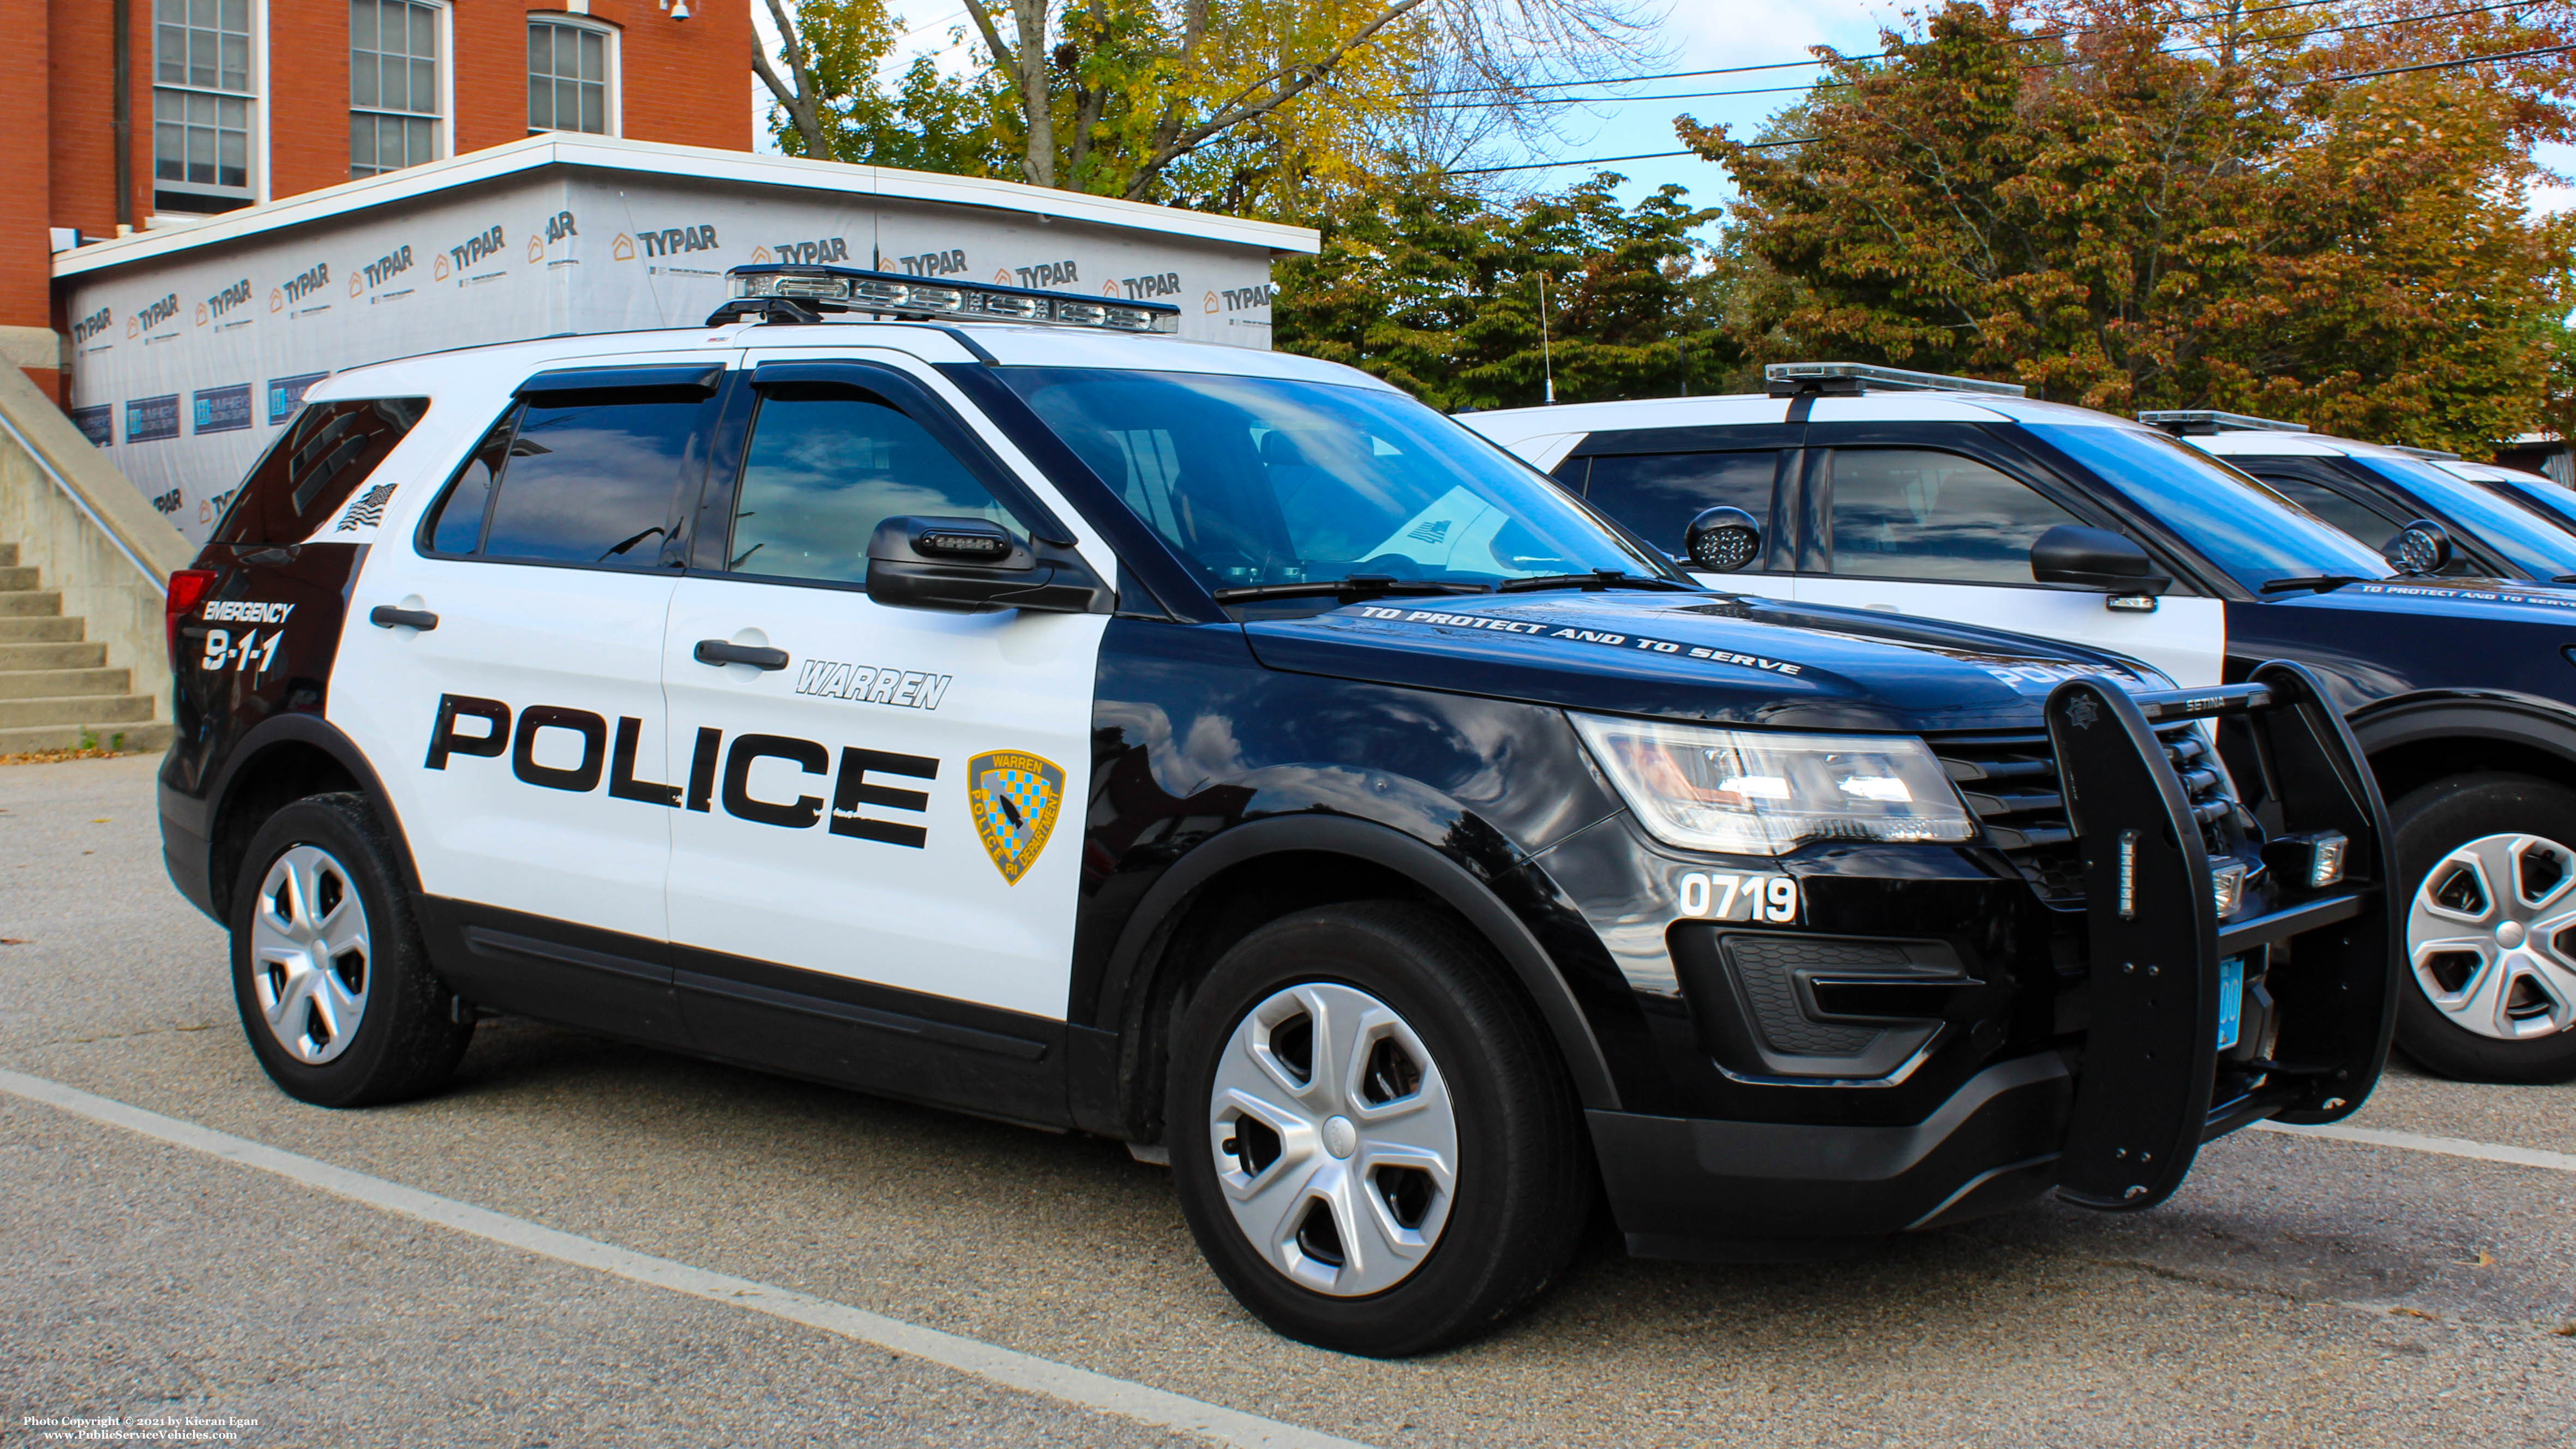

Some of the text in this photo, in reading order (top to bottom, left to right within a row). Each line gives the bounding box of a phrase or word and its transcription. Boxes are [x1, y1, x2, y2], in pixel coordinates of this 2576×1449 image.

[546, 211, 579, 245] AR
[637, 225, 719, 257] TYPAR
[363, 245, 415, 289] TYPAR
[450, 225, 506, 271] TYPAR
[774, 237, 849, 265] TYPAR
[899, 249, 968, 276] TYPAR
[283, 262, 330, 304] TYPAR
[1015, 260, 1079, 289] TYPAR
[1122, 273, 1181, 300] TYPAR
[138, 293, 179, 331] TYPAR
[208, 279, 253, 318] TYPAR
[74, 306, 112, 344] TYPAR
[153, 488, 183, 515] PAR
[2362, 585, 2383, 593] TO
[2387, 587, 2457, 598] PROTECT
[2460, 592, 2496, 600] AND
[202, 601, 296, 623] EMERGENCY
[201, 628, 285, 672] 9-1-1
[1361, 606, 1802, 676] TO PROTECT AND TO SERVE
[796, 659, 952, 710] WARREN
[2186, 696, 2225, 712] SETINA
[424, 693, 940, 849] POLICE
[993, 755, 1043, 773] WARREN
[971, 789, 1004, 861] POLICE
[1018, 789, 1059, 867] DEPARTMENT
[1005, 863, 1018, 875] RI
[1679, 873, 1798, 923] 0719
